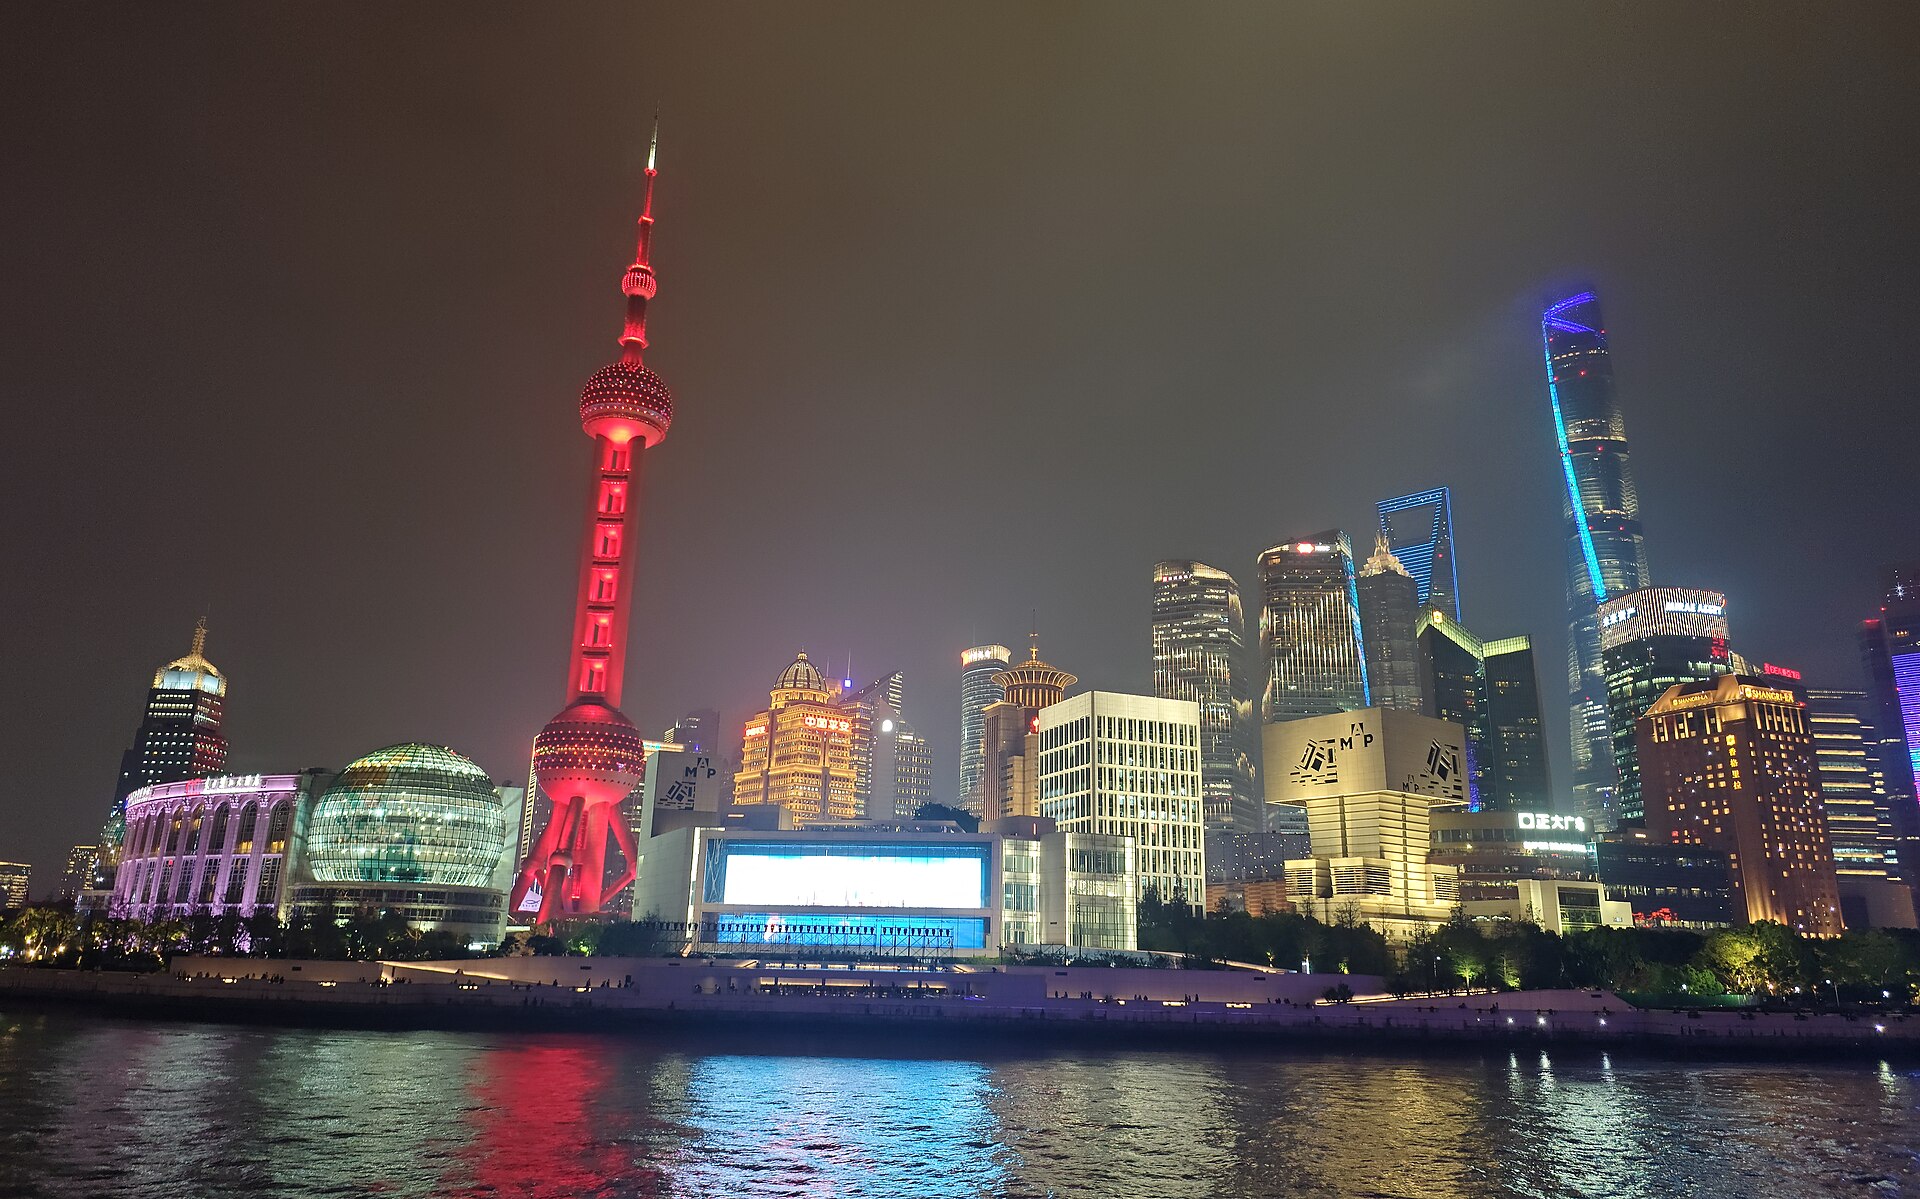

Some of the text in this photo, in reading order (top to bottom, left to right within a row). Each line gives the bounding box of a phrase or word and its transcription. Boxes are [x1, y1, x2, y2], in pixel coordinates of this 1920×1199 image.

[1678, 694, 1709, 705] SHANGRI-LA
[1751, 688, 1795, 703] SHANGRI-LA
[804, 716, 850, 732] 中国平安
[1340, 722, 1374, 750] MAP
[685, 757, 717, 779] MAP
[1728, 747, 1742, 790] 香格里拉
